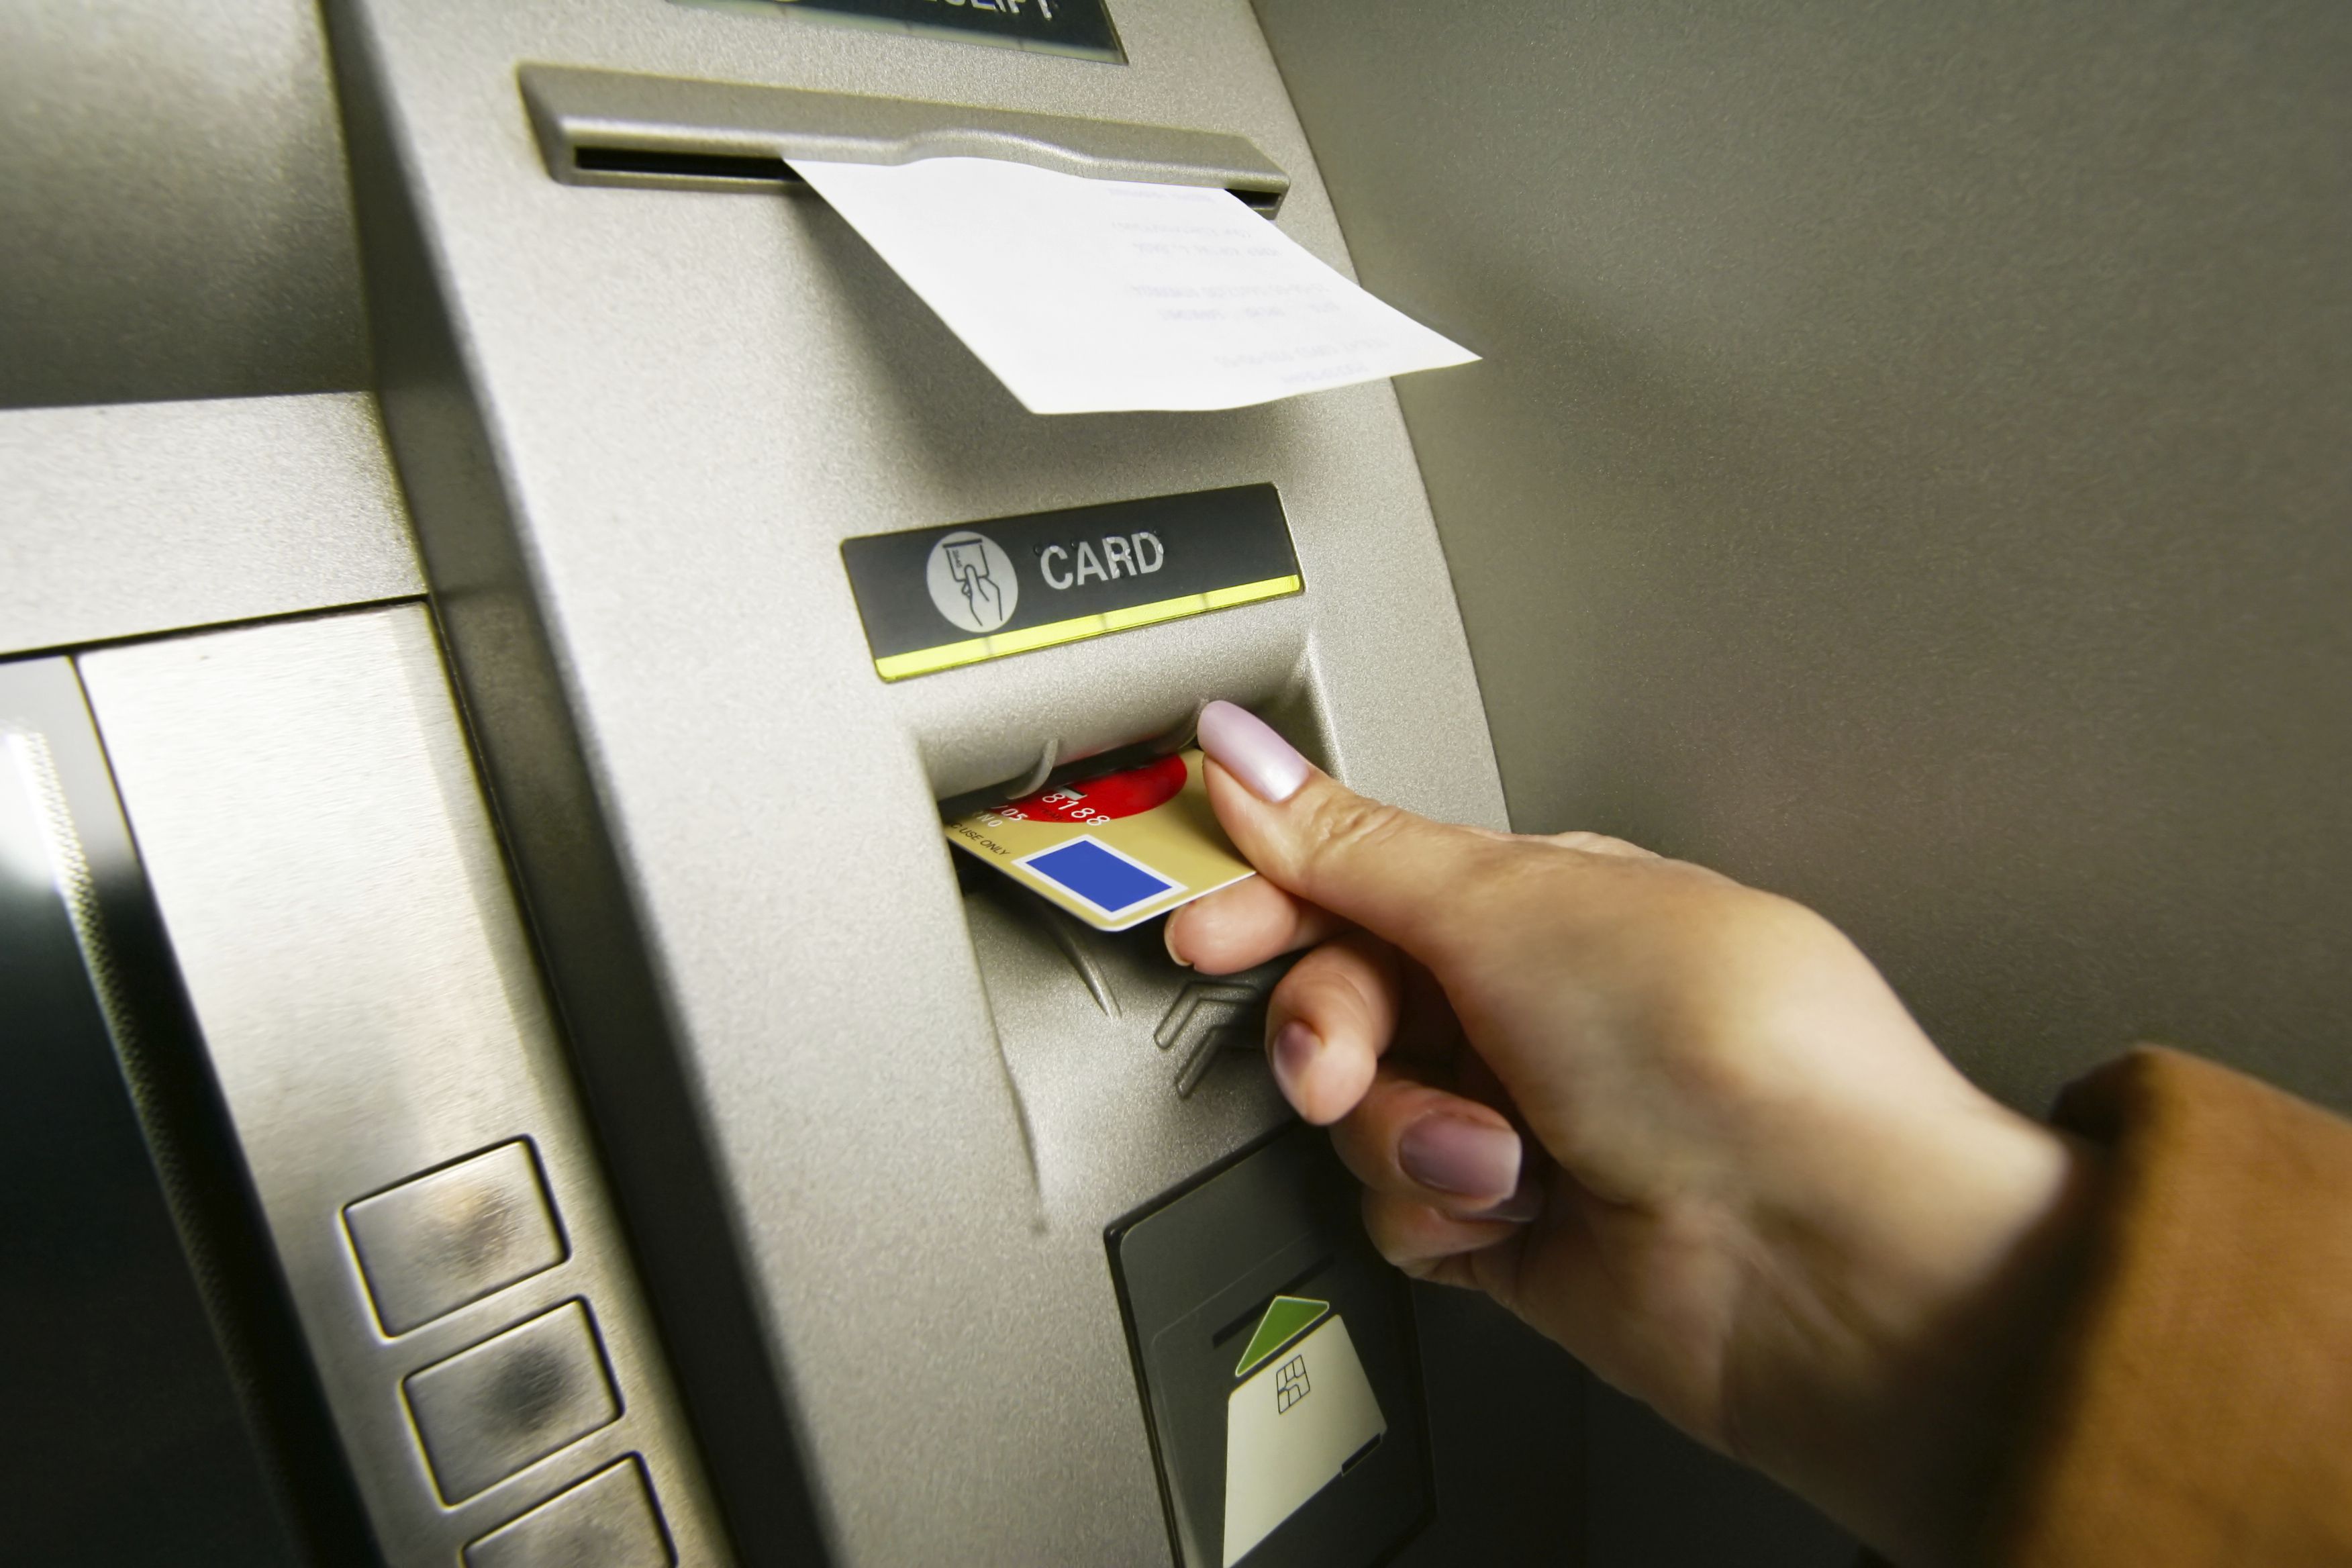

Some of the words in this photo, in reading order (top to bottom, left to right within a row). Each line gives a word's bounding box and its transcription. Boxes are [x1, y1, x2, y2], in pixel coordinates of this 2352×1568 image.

[1040, 532, 1165, 590] CARD
[1042, 793, 1111, 826] 8188
[959, 827, 984, 841] USE
[980, 840, 1011, 855] ONLY
